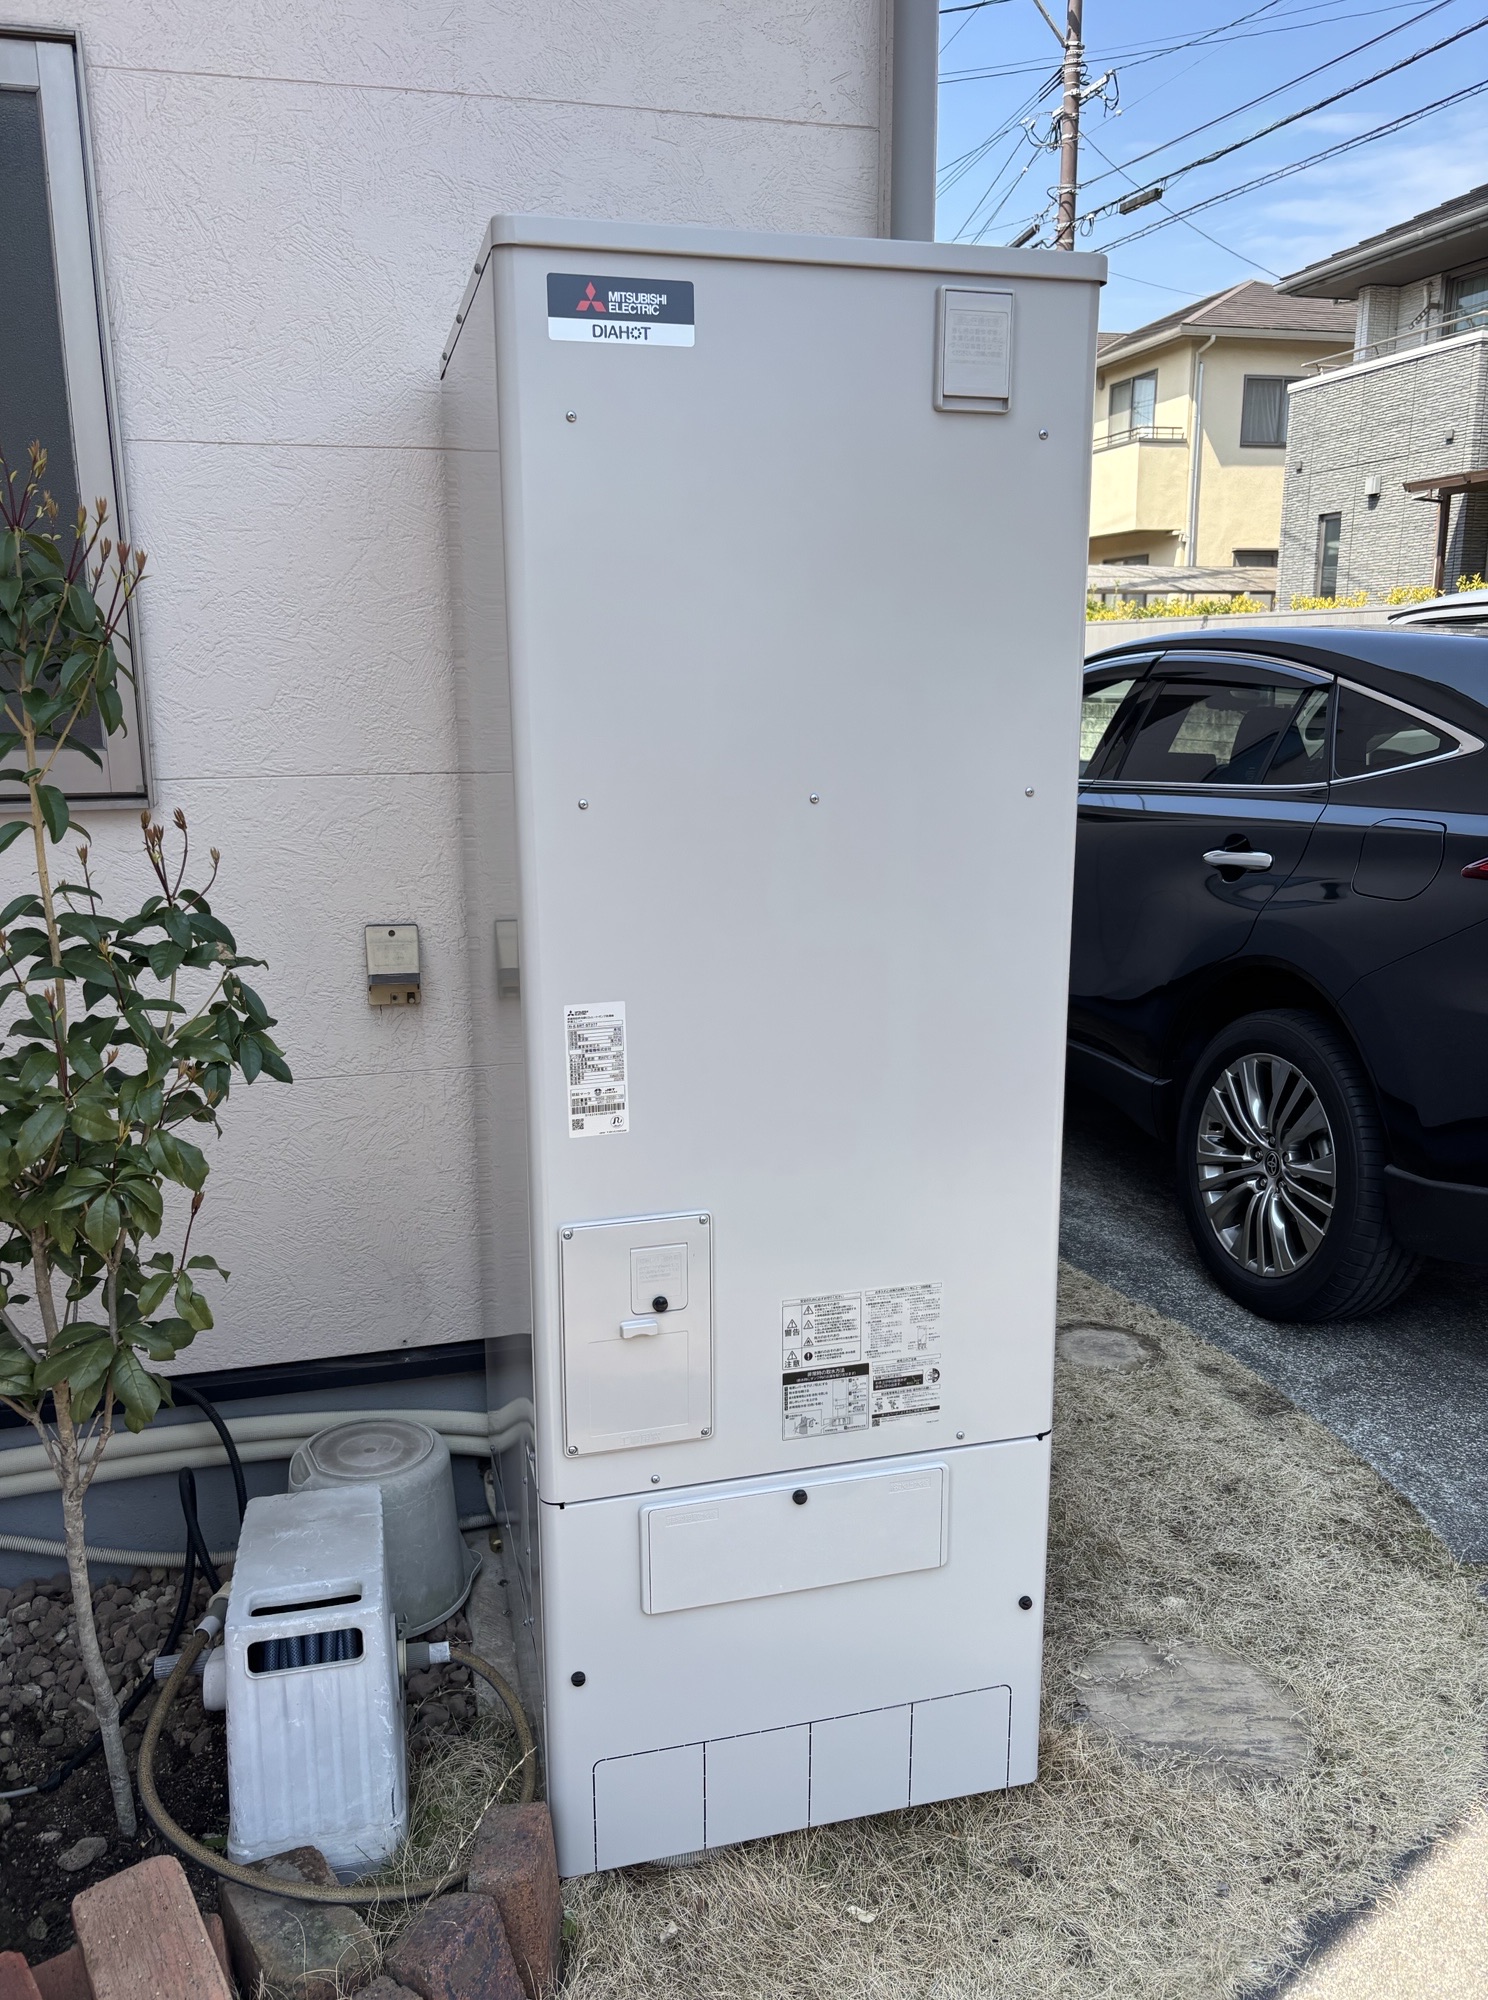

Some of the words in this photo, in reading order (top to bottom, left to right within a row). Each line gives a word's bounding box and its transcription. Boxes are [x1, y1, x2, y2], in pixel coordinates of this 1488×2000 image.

[608, 290, 667, 305] MITSUBISHI
[608, 303, 660, 316] ELECTRIC
[592, 324, 651, 341] DIAHOT
[784, 1328, 800, 1337] 警告
[784, 1359, 800, 1368] 注意
